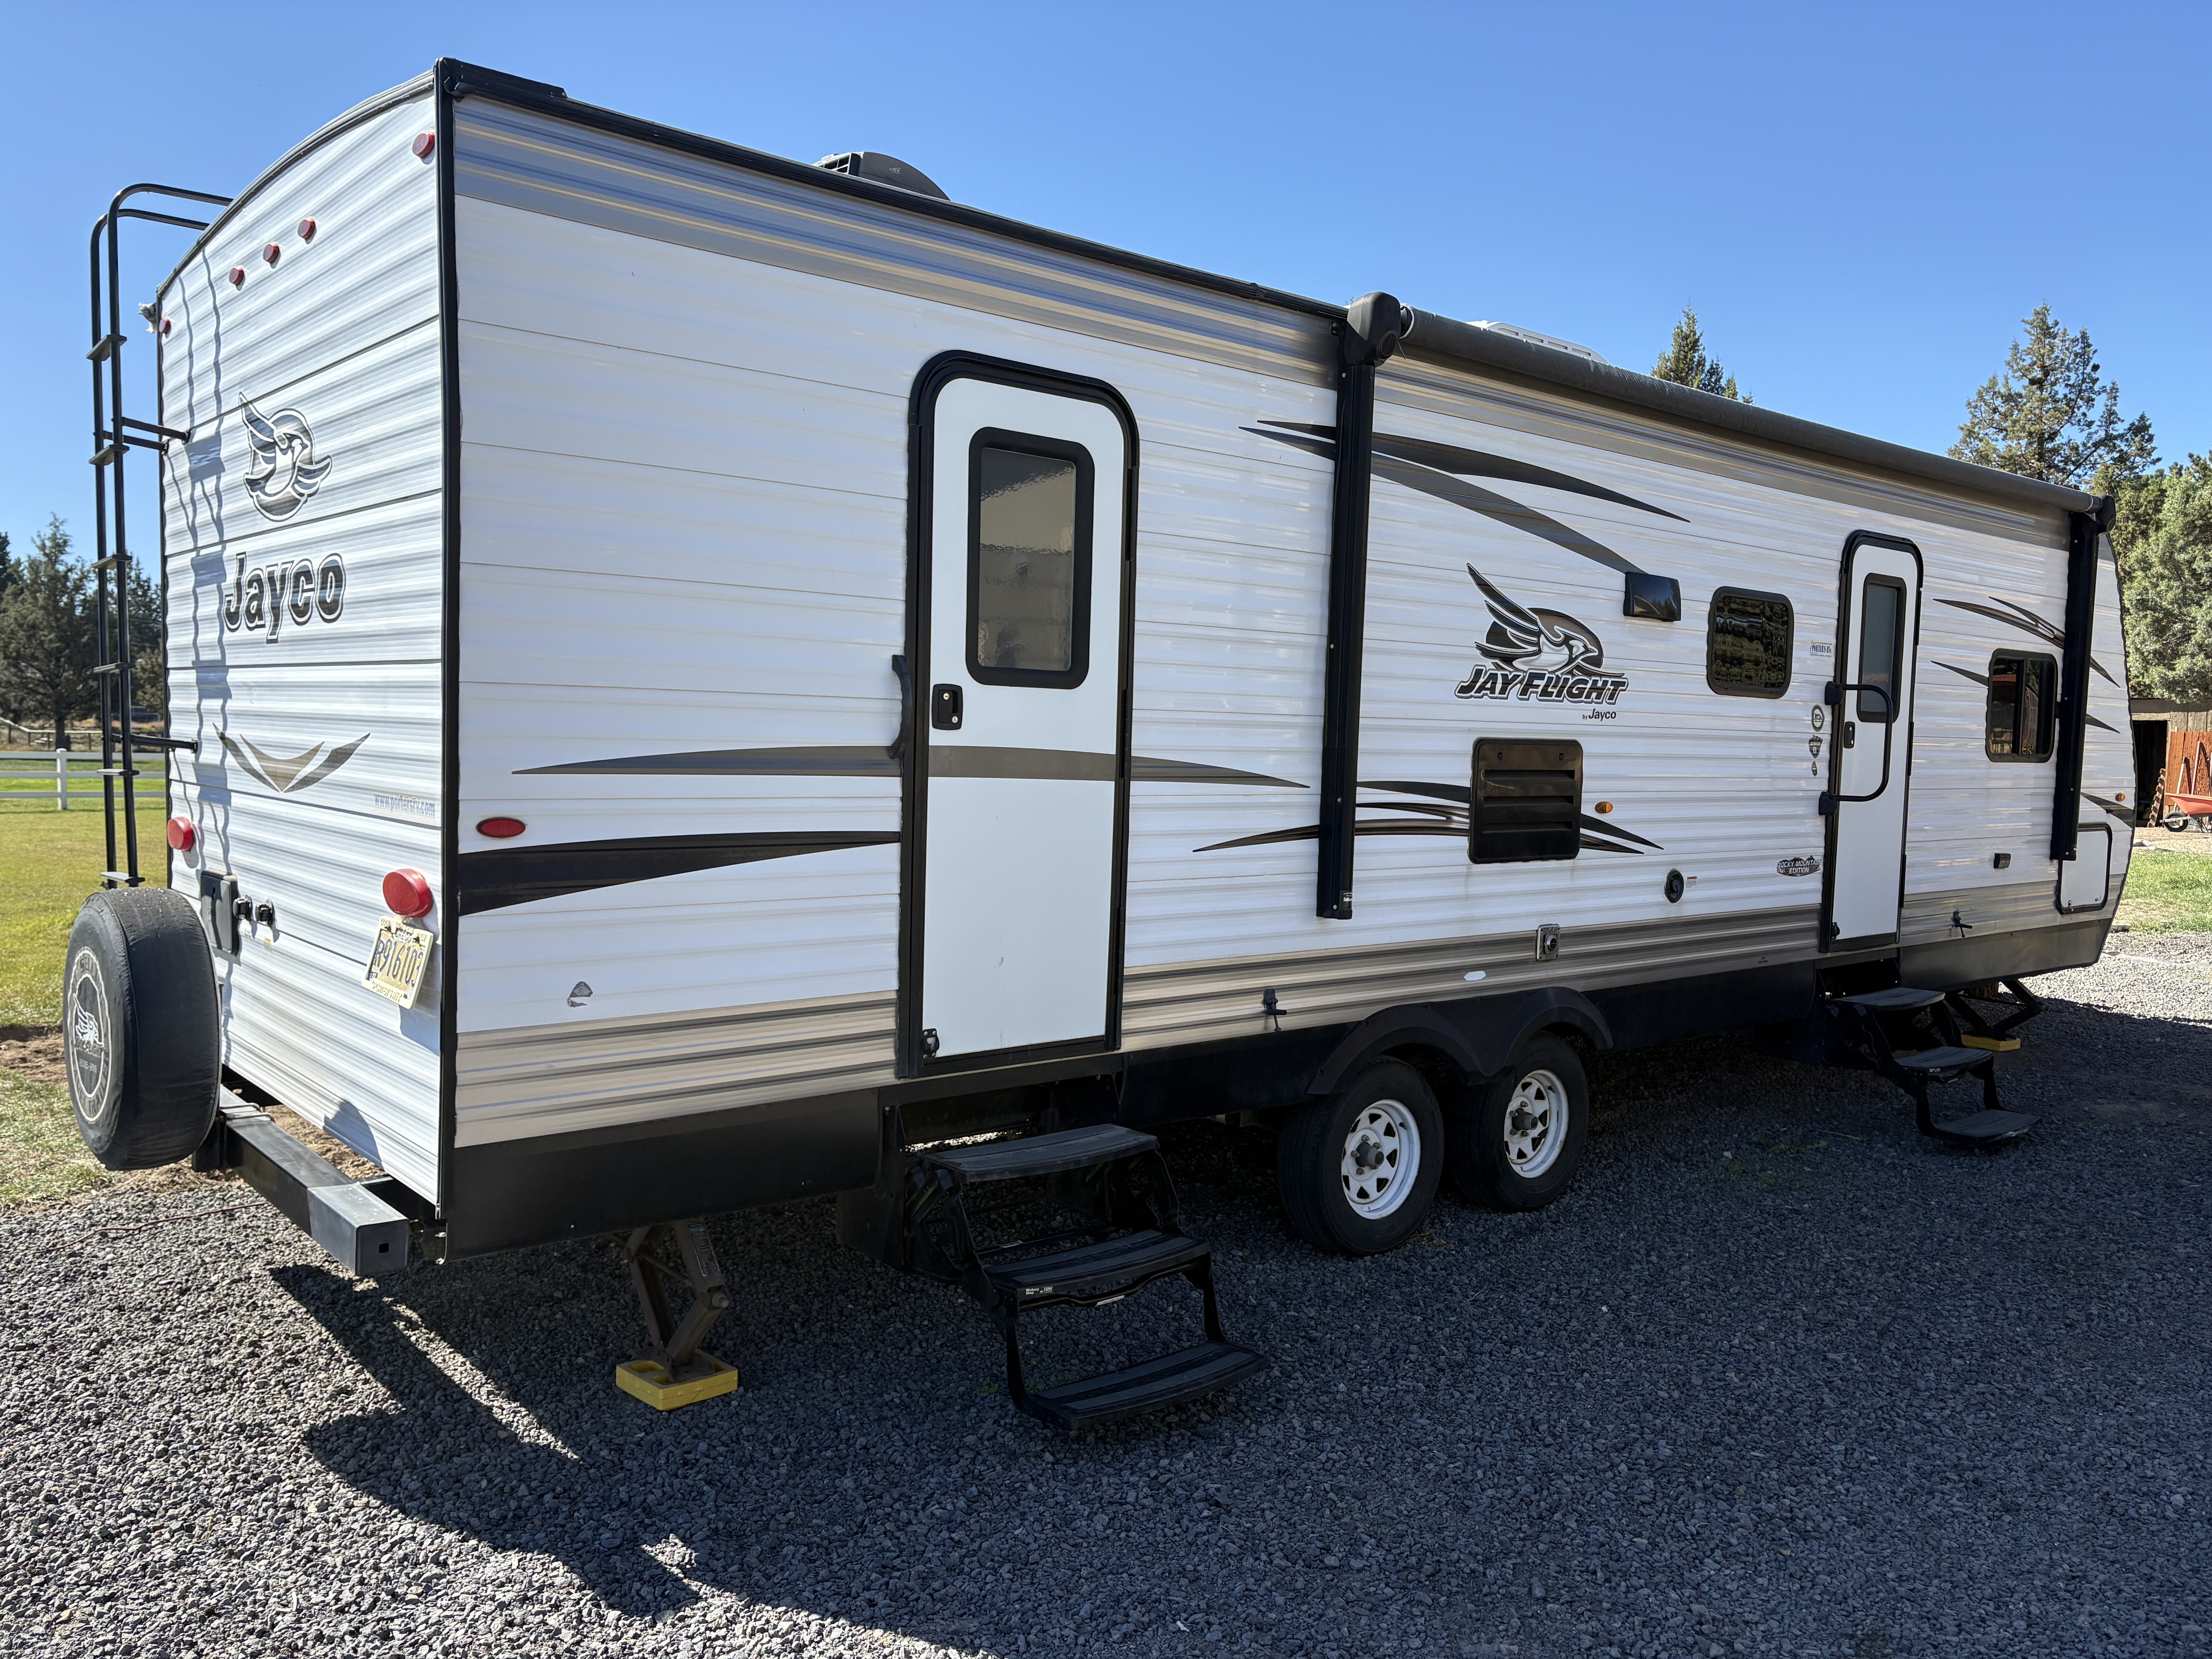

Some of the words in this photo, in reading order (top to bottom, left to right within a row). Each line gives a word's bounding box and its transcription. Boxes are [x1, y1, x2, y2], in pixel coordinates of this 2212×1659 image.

[223, 551, 345, 644] Jayco
[1455, 665, 1523, 699] JAY
[1517, 668, 1628, 705] FLIGHT
[1589, 708, 1616, 721] Jayco
[374, 794, 435, 816] www.portersrv.com
[373, 938, 424, 988] R916103
